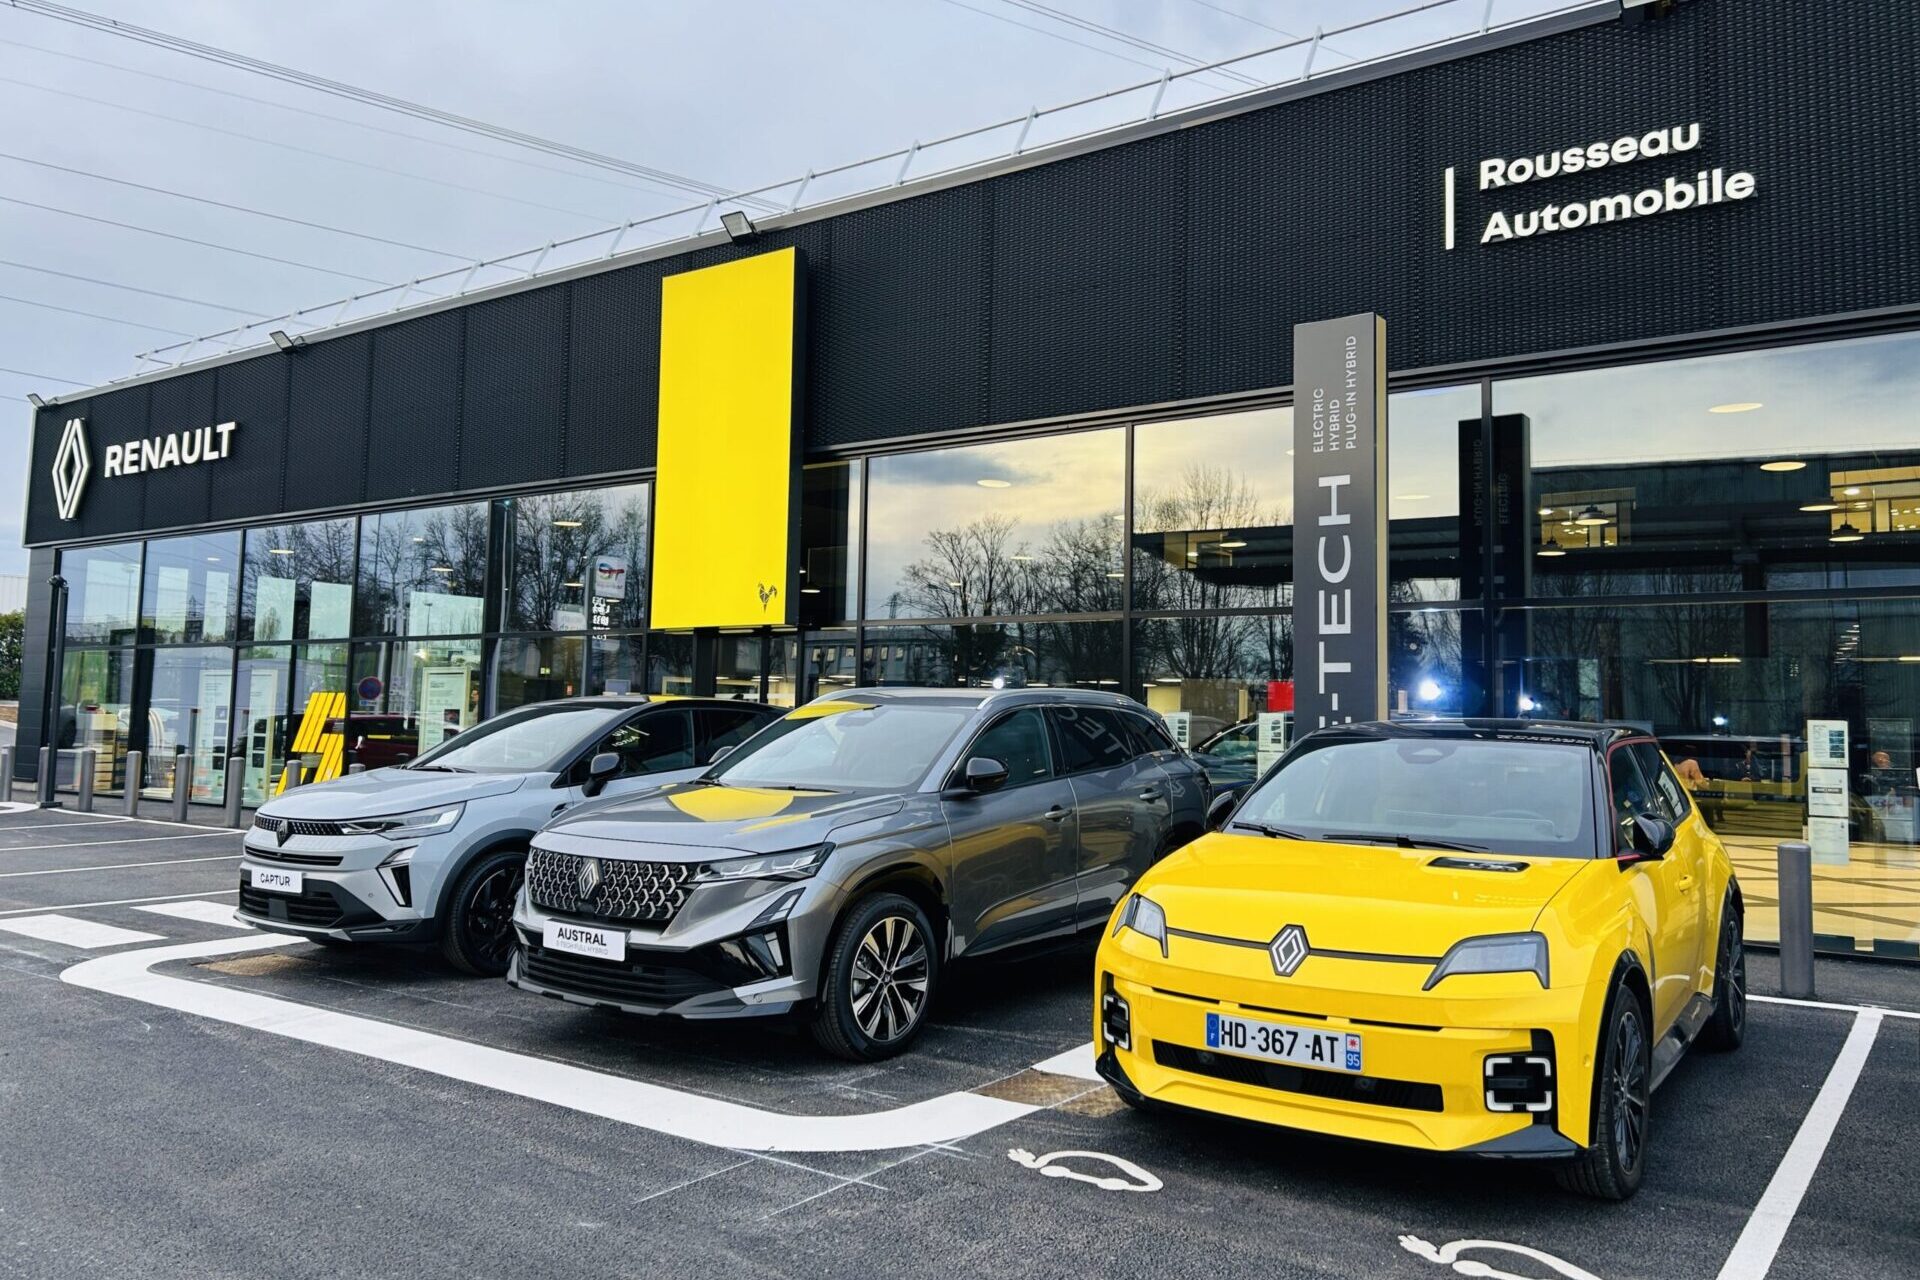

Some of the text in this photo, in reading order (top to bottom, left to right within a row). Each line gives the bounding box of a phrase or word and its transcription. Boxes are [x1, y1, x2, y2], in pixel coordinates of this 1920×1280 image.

[1479, 122, 1701, 191] Rousseau
[1480, 167, 1756, 244] Automobile
[1345, 336, 1357, 449] PLUG-IN HYBRID
[1313, 388, 1324, 453] ELECTRIC
[1329, 399, 1340, 451] HYBRID
[104, 421, 236, 478] RENAULT
[260, 873, 291, 887] CAPTUR
[557, 927, 607, 946] AUSTRAL
[1221, 1020, 1339, 1064] HD-367-AT
[1346, 1053, 1360, 1067] 95
